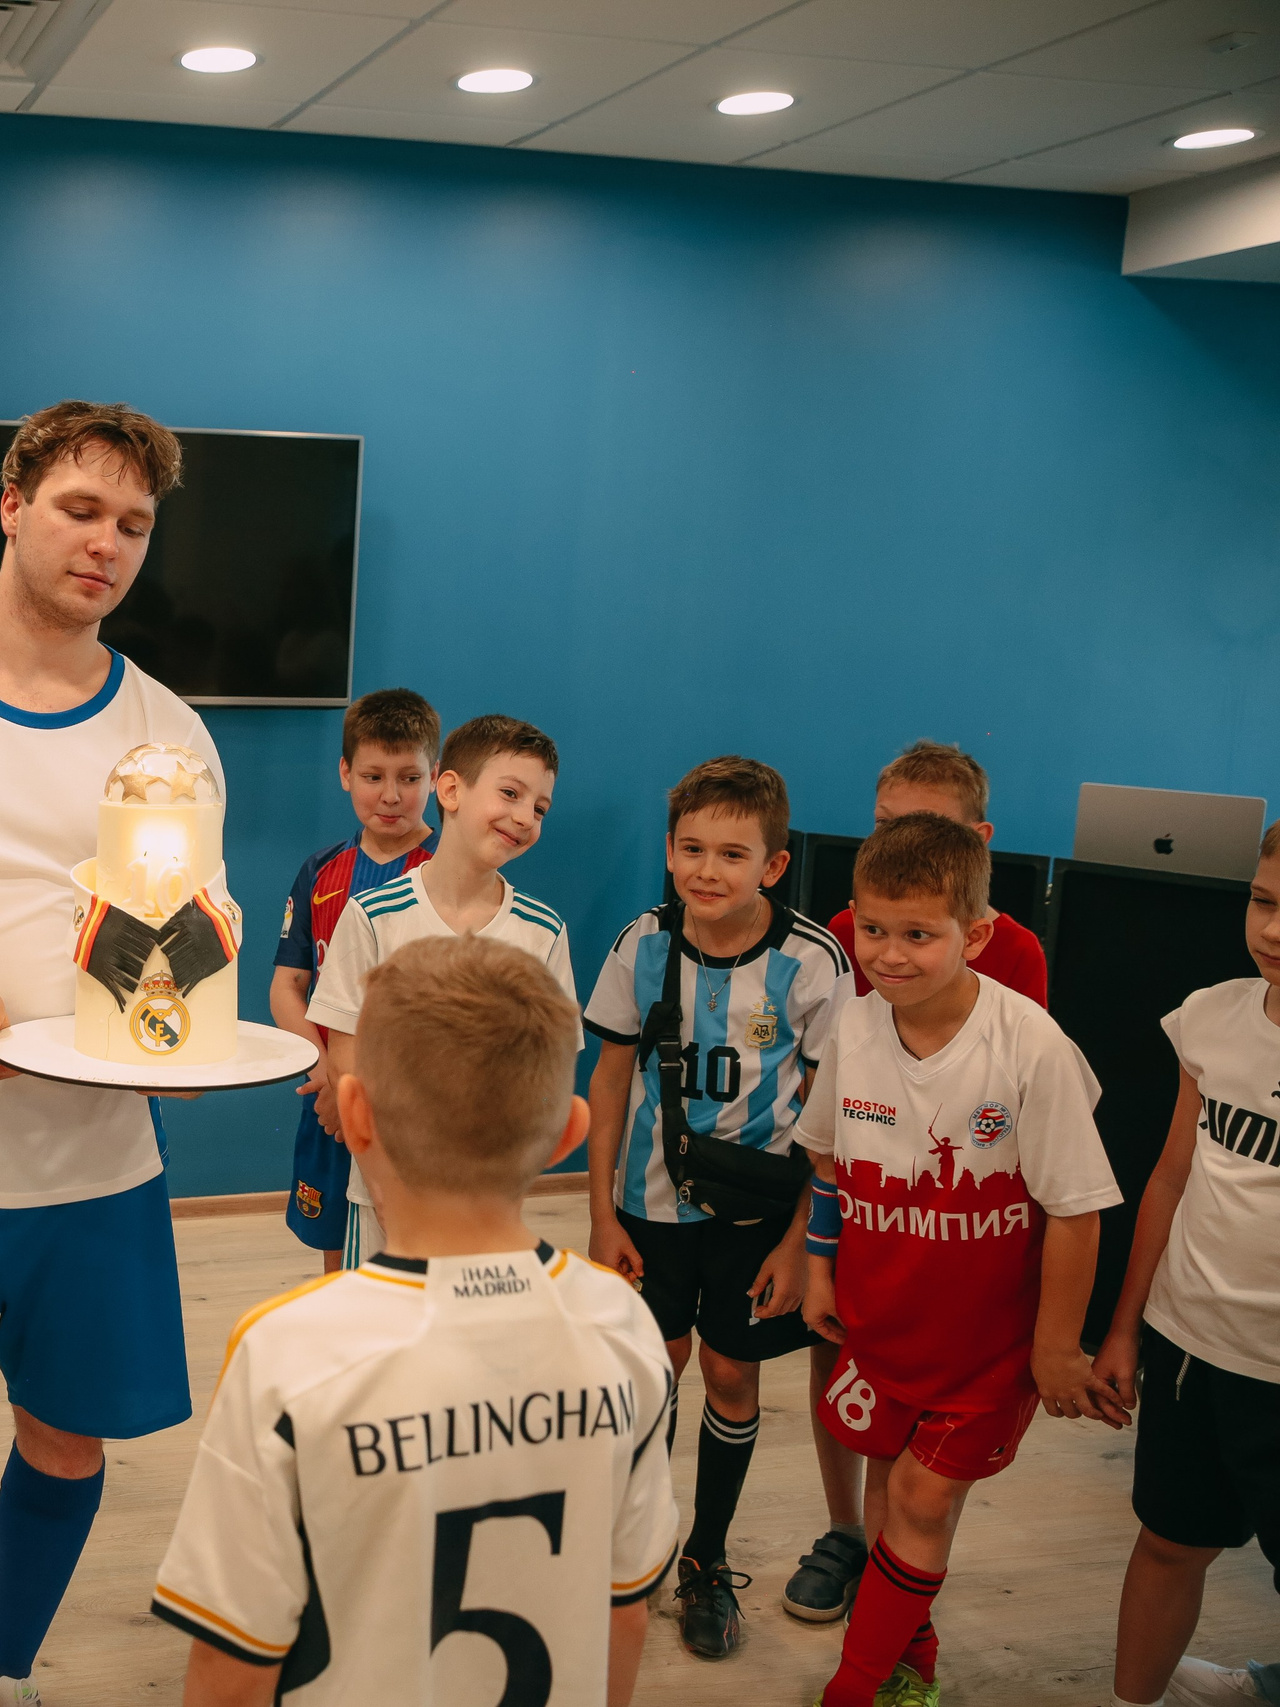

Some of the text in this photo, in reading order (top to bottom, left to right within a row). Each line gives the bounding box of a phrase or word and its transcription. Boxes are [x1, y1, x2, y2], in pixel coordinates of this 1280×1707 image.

[678, 1041, 741, 1103] 10
[843, 1097, 896, 1117] BOSTON
[843, 1108, 896, 1126] TECHNIC
[1198, 1093, 1280, 1168] UM
[837, 1188, 1030, 1241] ОЛИМПИЯ
[453, 1278, 531, 1298] MADRID!
[825, 1357, 877, 1432] 18
[429, 1489, 567, 1707] 5
